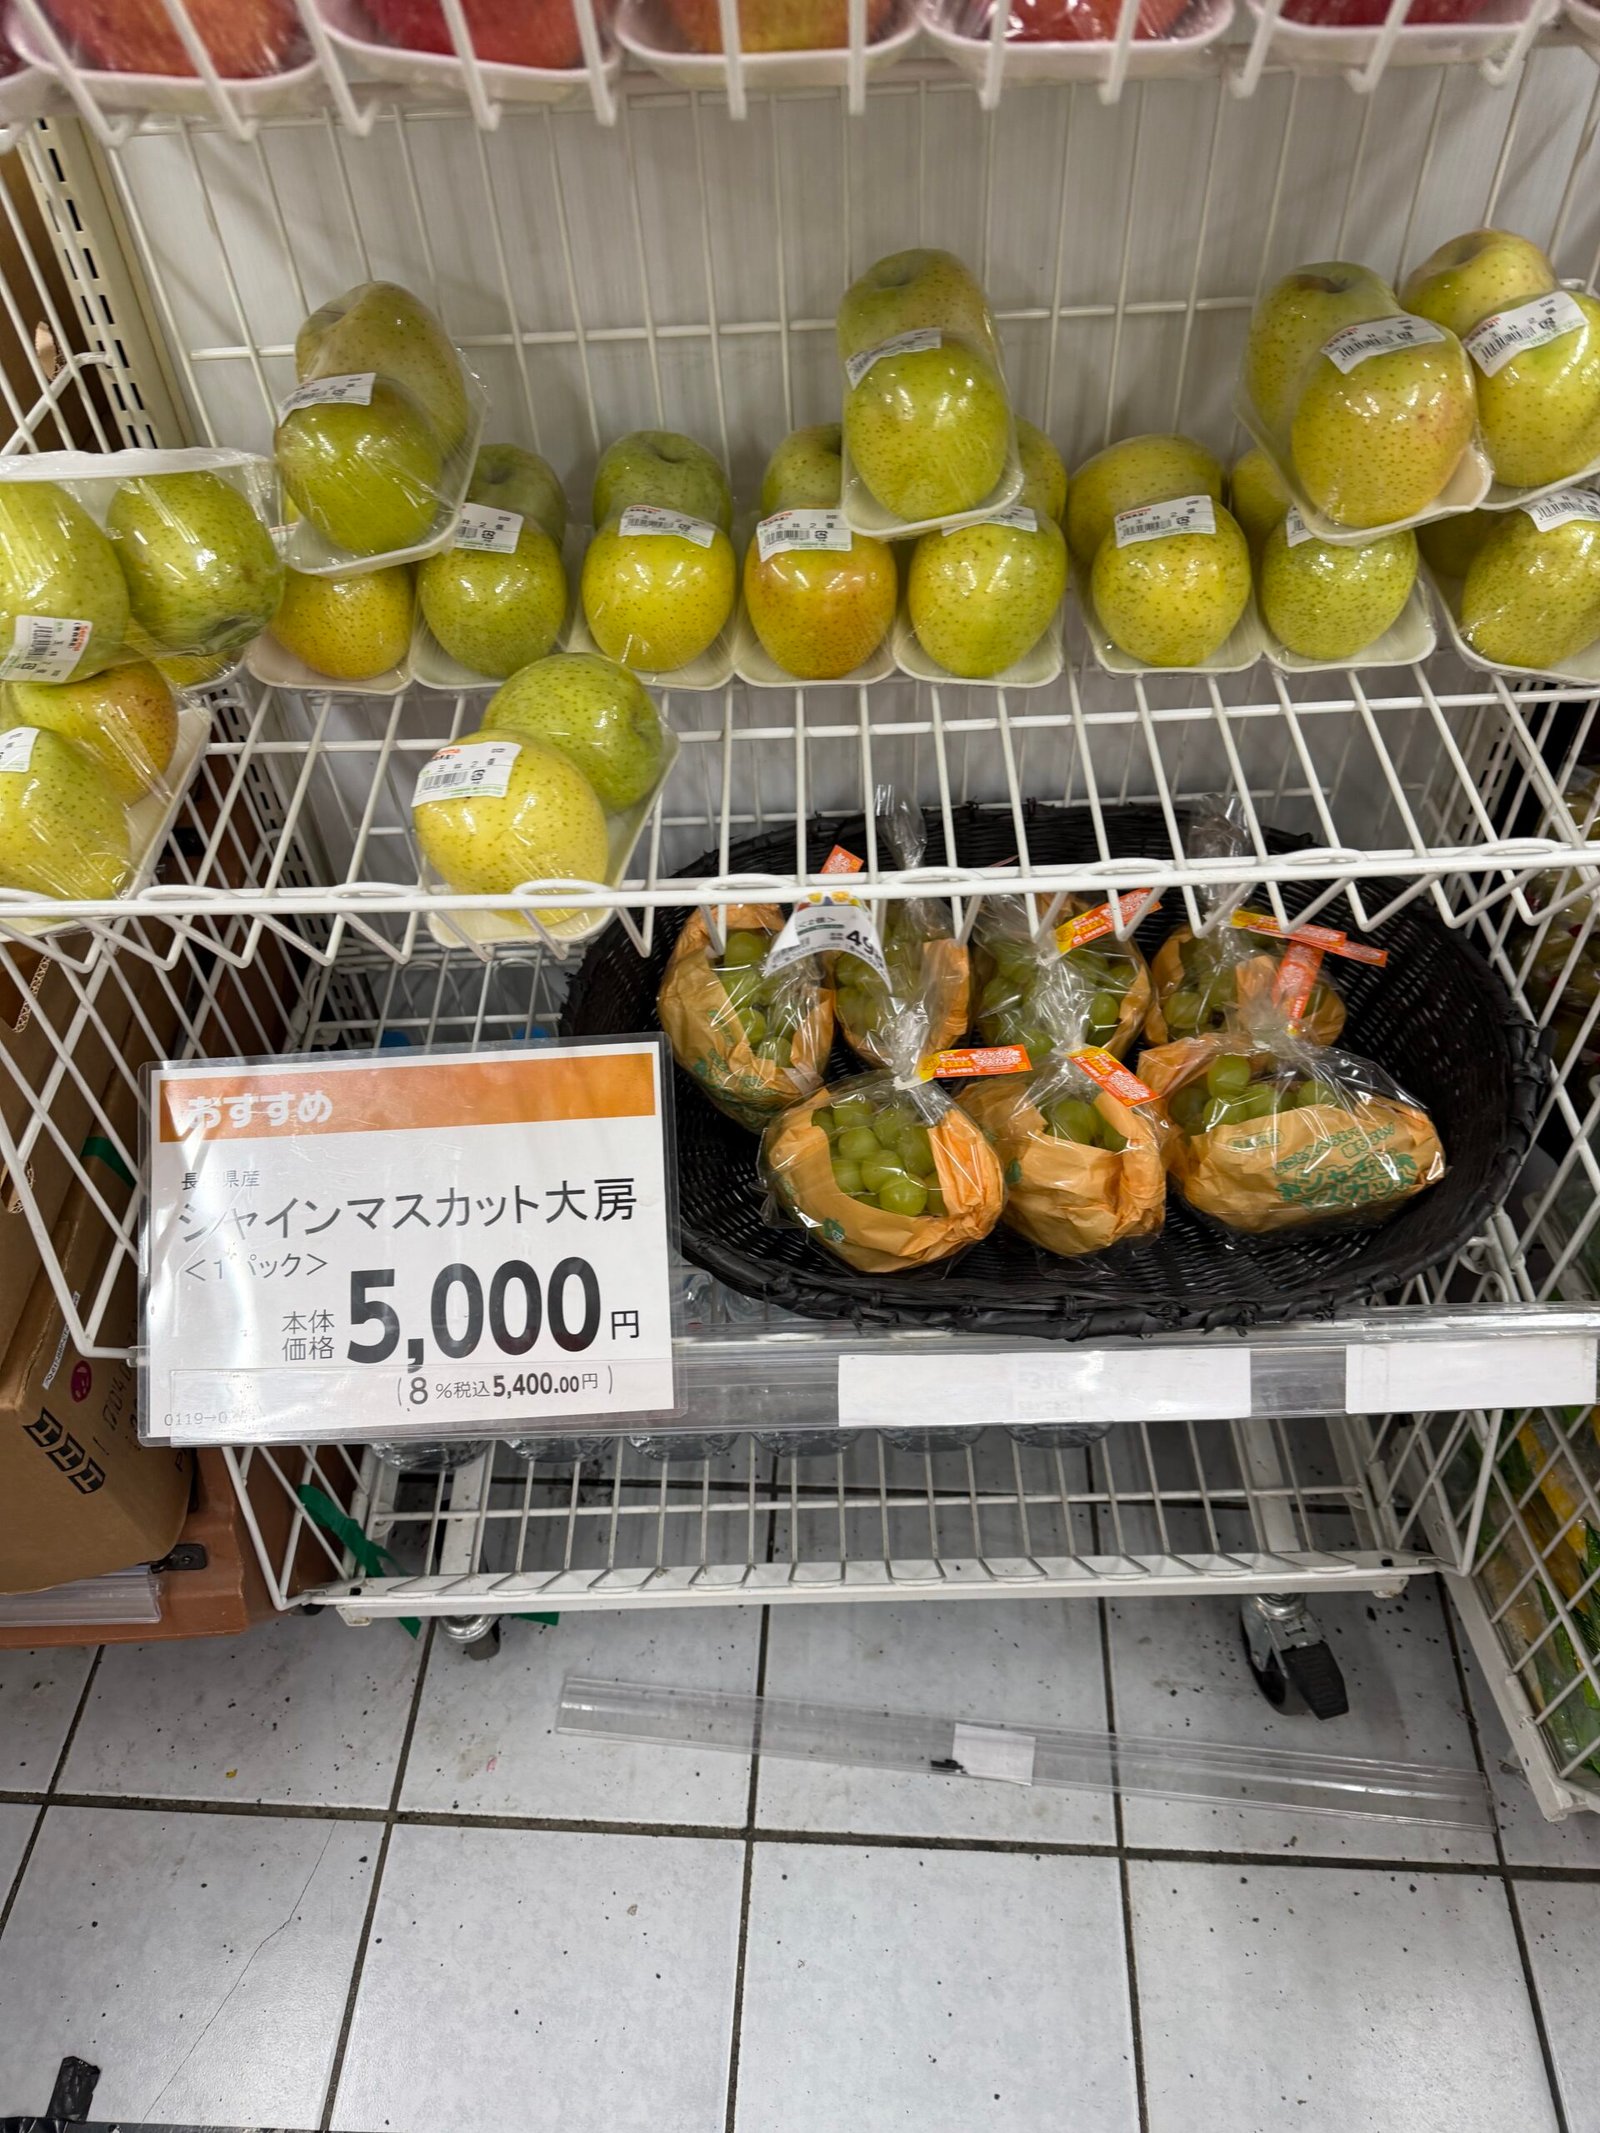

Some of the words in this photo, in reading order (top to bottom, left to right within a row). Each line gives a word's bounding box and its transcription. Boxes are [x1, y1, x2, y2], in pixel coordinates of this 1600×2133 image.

[187, 1090, 333, 1129] おすすめ
[181, 1169, 260, 1191] 長県産
[178, 1177, 638, 1243] シャインマスカット大房
[281, 1309, 335, 1335] 本体
[281, 1335, 335, 1362] 価格
